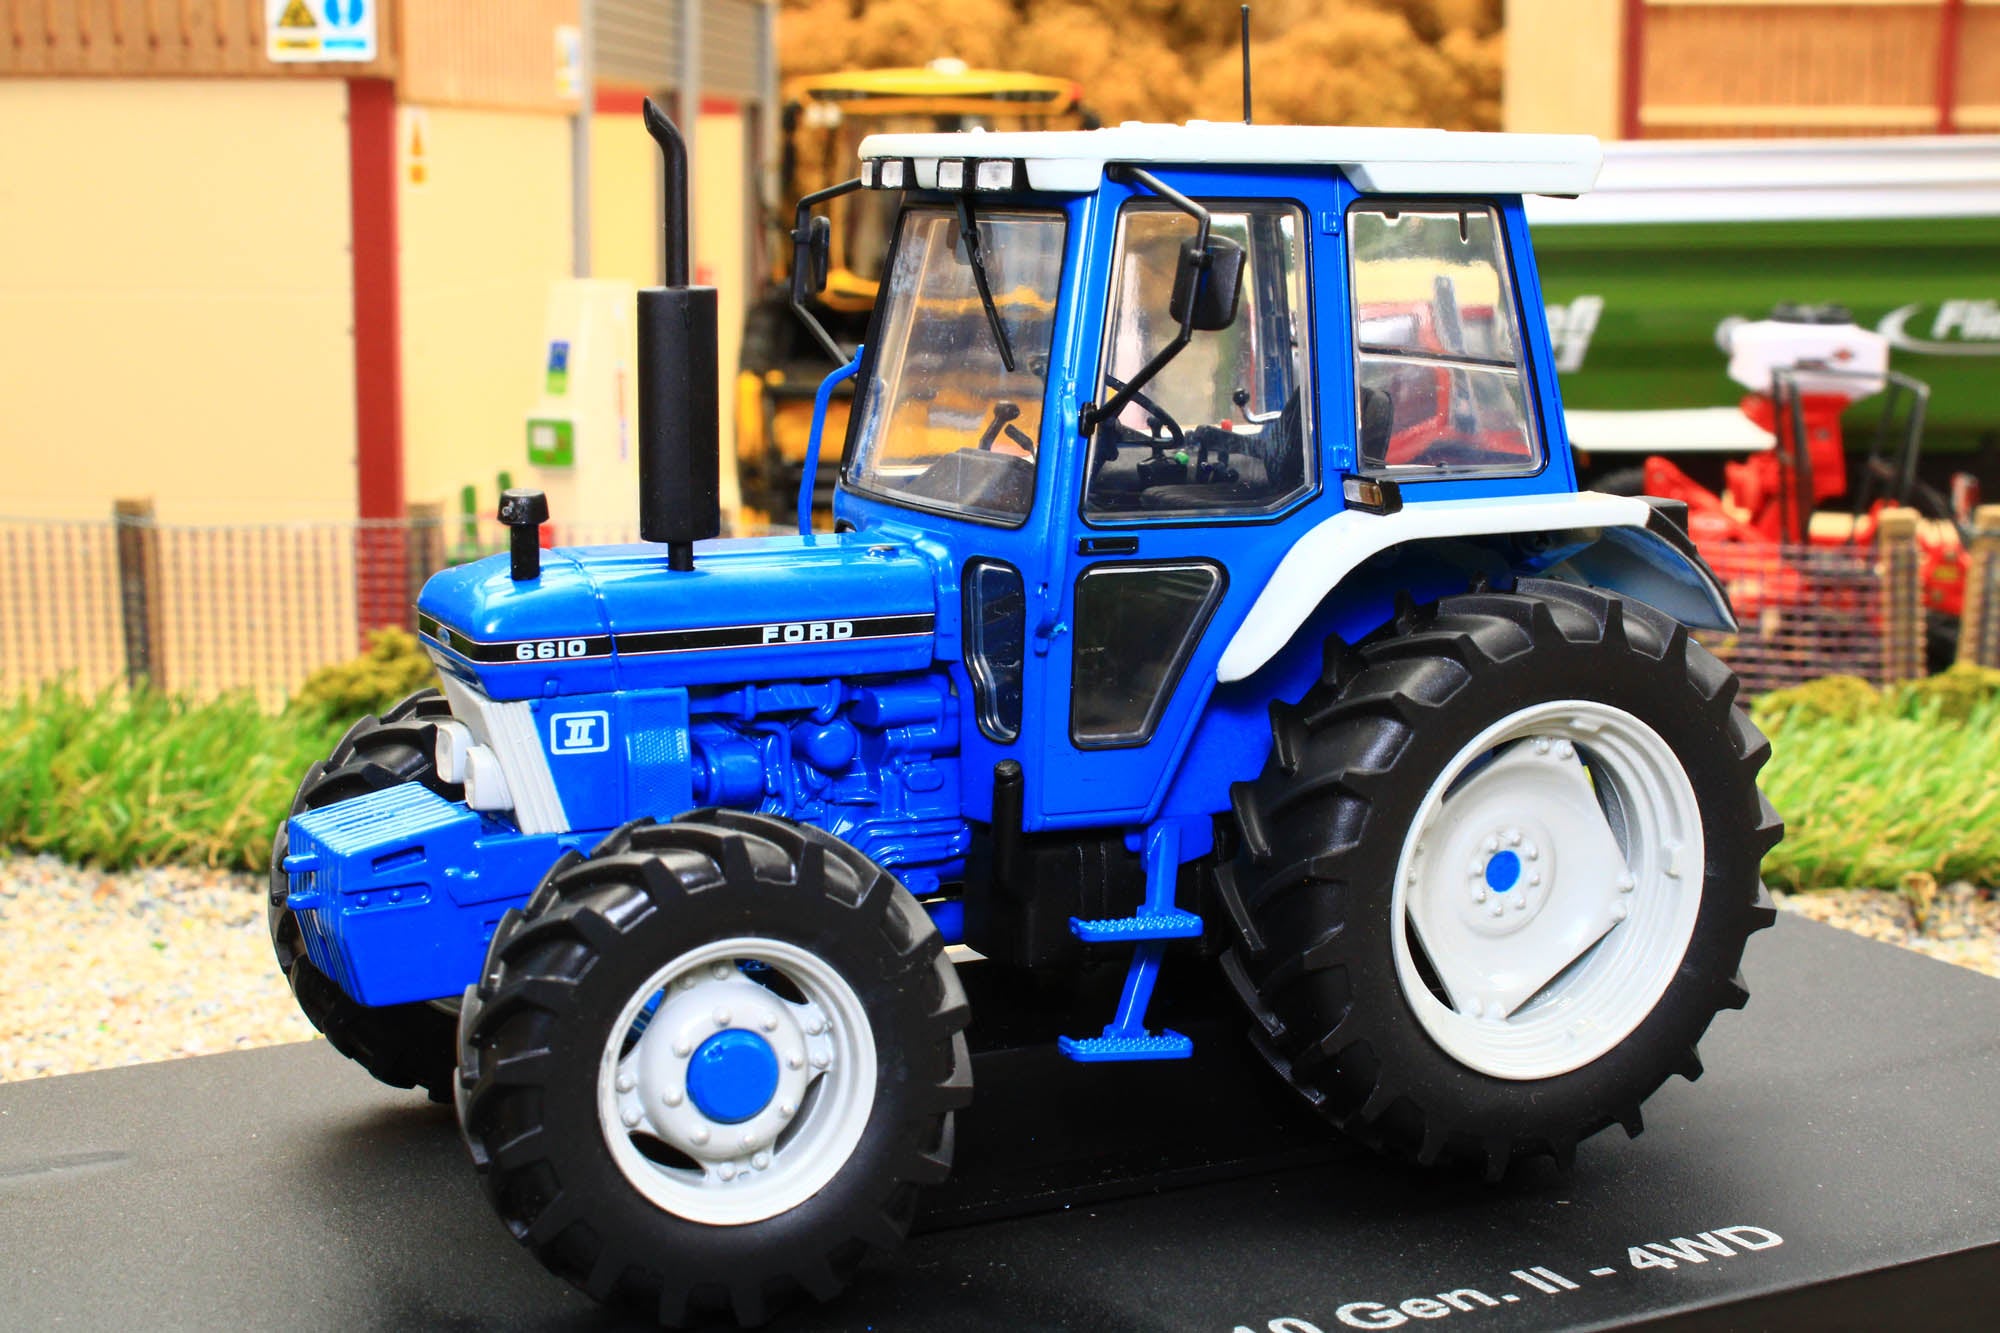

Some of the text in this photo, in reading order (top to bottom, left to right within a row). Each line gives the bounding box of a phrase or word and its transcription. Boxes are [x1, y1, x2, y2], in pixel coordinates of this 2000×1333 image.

[762, 622, 854, 644] FORD
[516, 640, 587, 661] 6610
[1335, 1288, 1520, 1330] Gen.
[1628, 1225, 1784, 1269] 4WD
